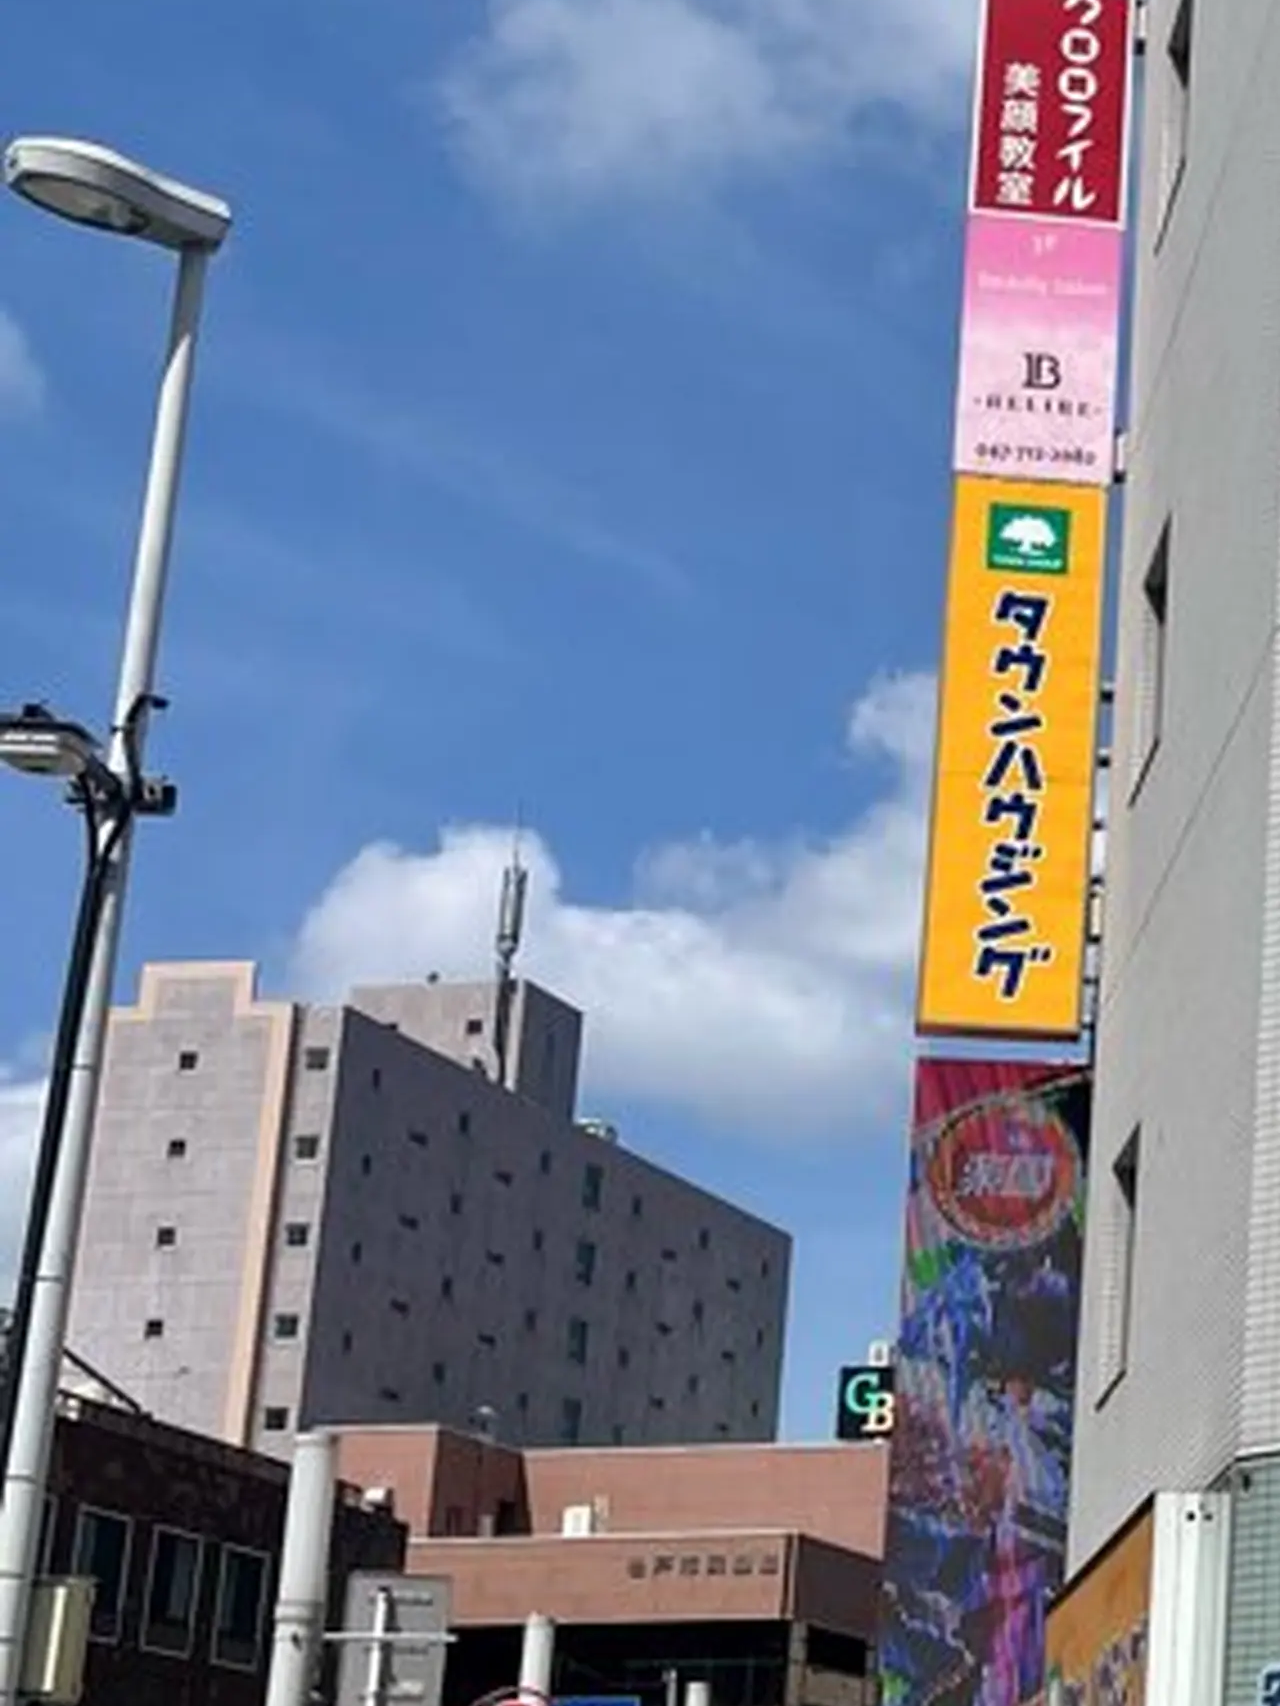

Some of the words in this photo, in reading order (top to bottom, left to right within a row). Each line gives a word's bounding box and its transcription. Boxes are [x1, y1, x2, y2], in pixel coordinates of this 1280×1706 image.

[996, 61, 1039, 207] 美顔教室
[975, 592, 1051, 998] タウンハウジング
